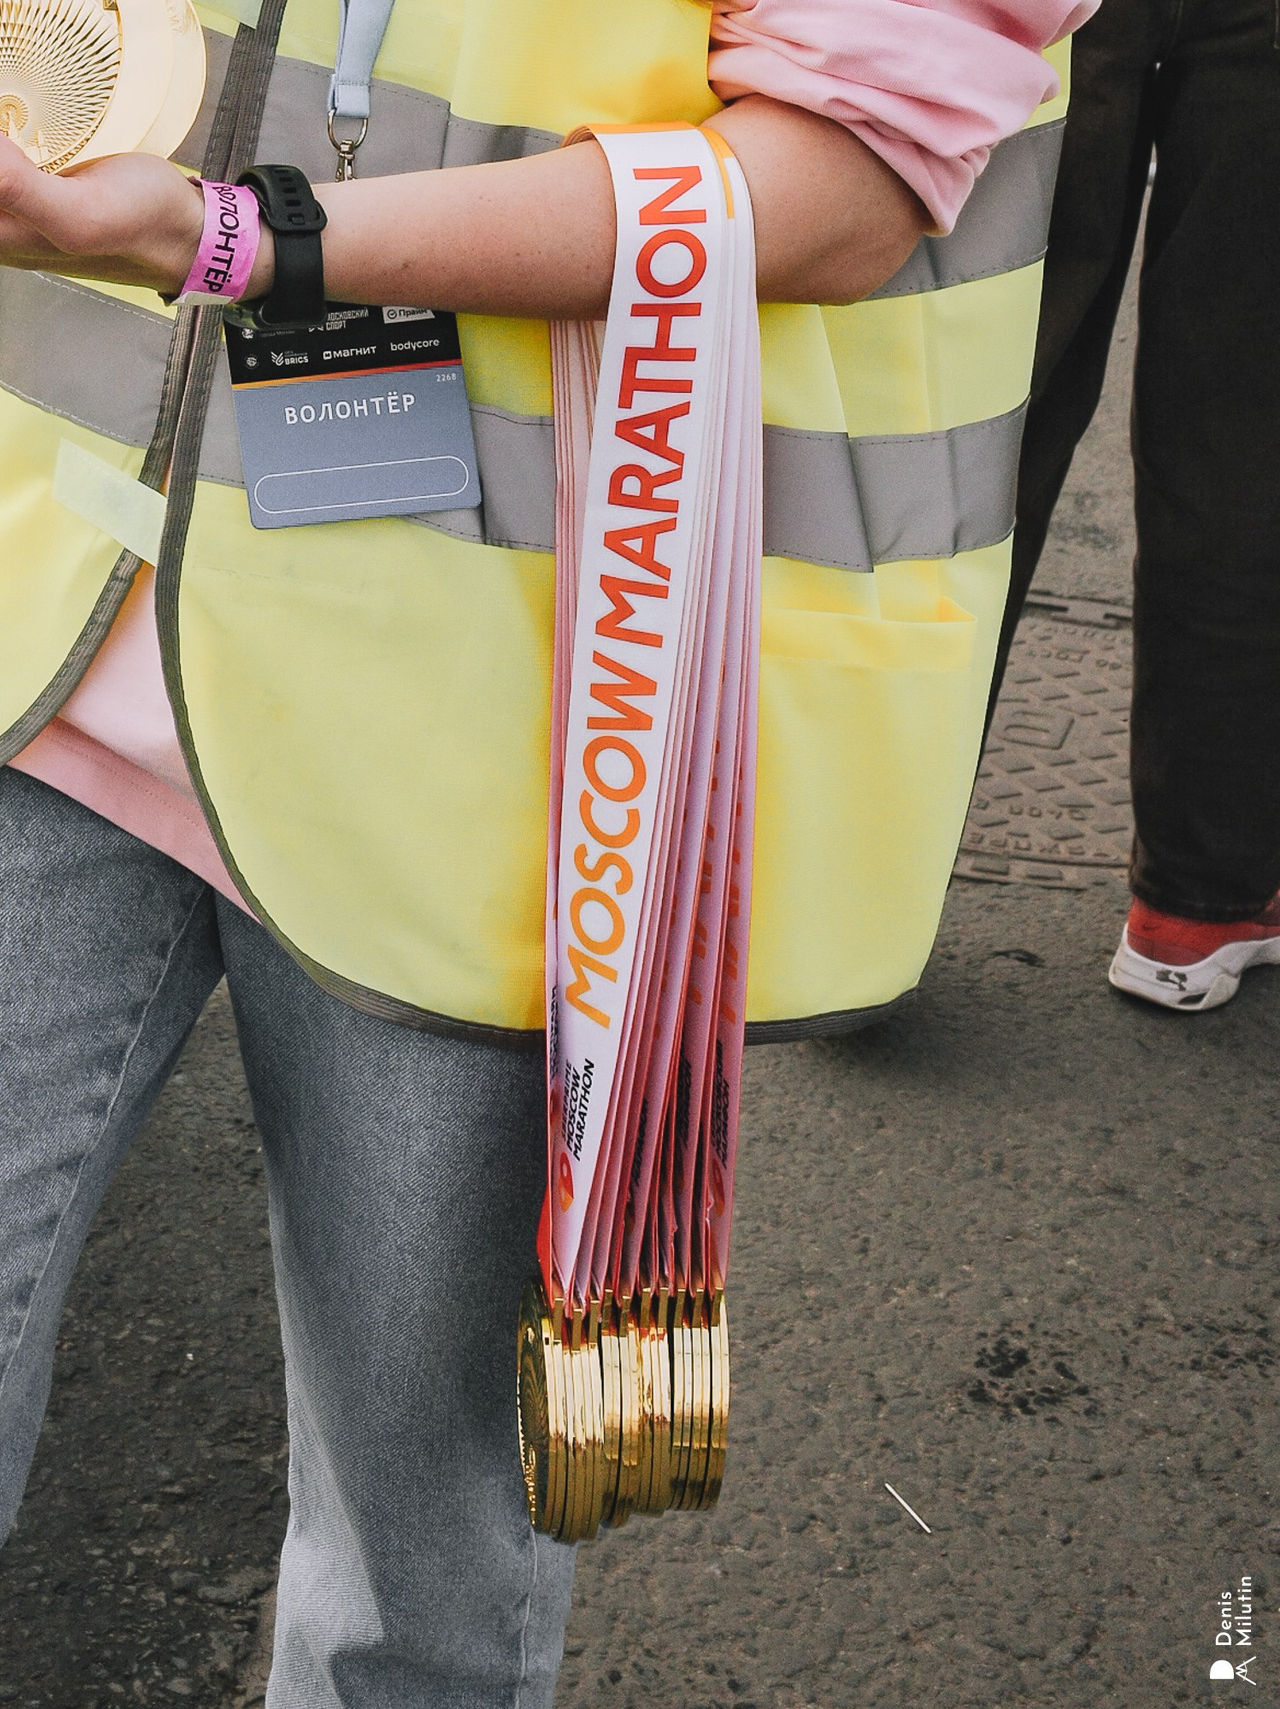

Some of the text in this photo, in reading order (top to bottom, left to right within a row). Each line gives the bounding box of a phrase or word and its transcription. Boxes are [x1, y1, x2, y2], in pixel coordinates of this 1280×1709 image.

[203, 183, 237, 294] ВОЛОНТЁР
[389, 337, 440, 352] bodycore
[435, 372, 457, 383] 2268
[284, 391, 416, 425] ВОЛОНТЁР
[565, 165, 708, 1030] MOSCOW MARATHON
[566, 1066, 582, 1152] MOSCOW
[572, 1057, 596, 1162] MARATHON
